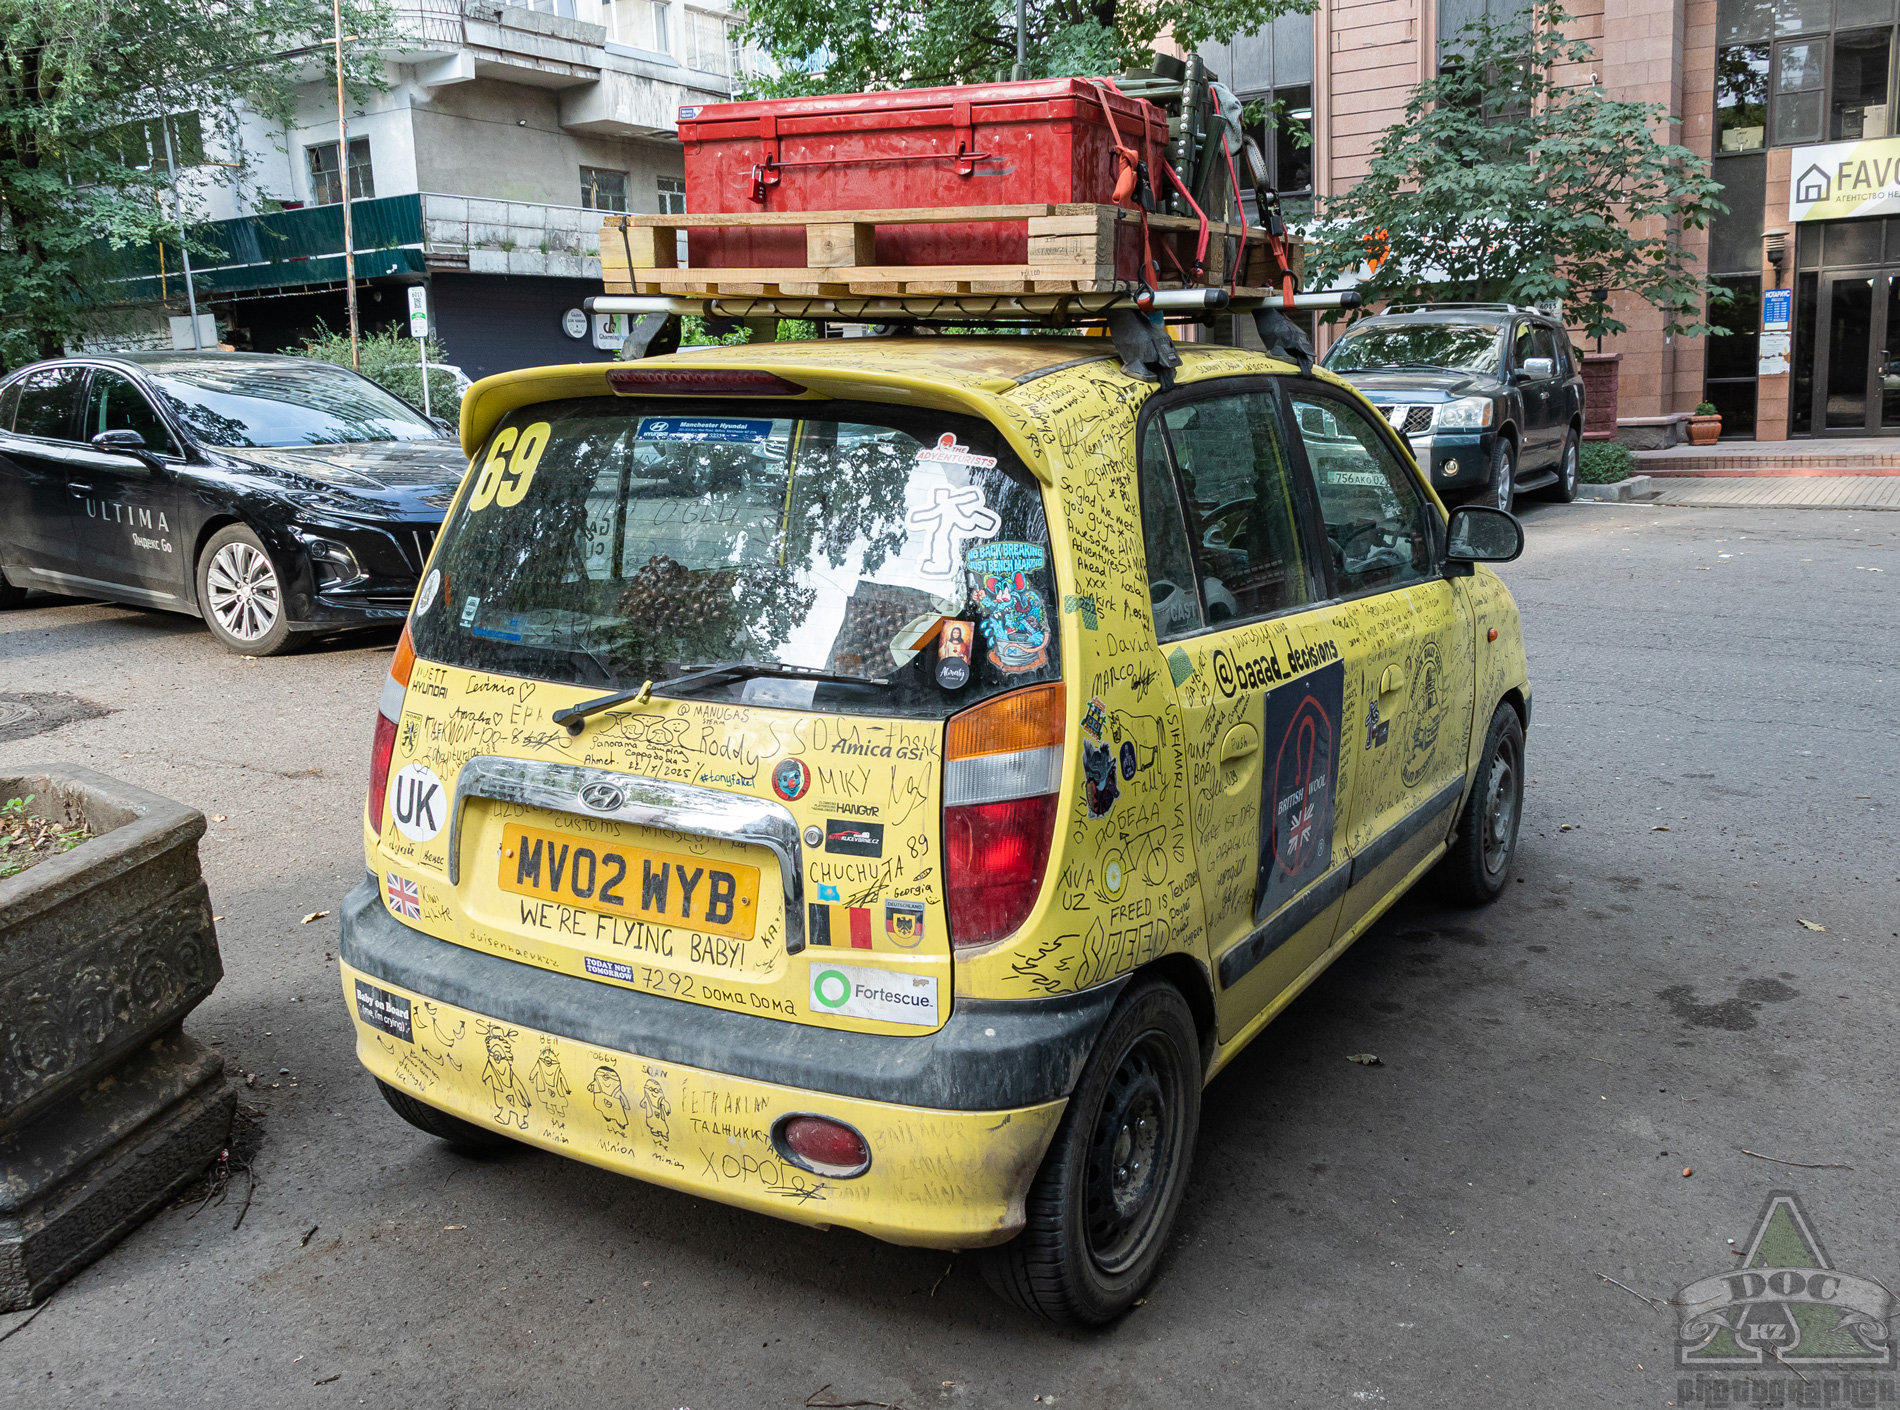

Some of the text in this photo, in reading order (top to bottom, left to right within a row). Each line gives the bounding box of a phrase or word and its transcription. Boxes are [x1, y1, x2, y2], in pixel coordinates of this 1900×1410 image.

[1836, 191, 1885, 203] АГЕНТСТВО
[470, 422, 551, 511] 69
[917, 452, 995, 467] ADVENTURISTS
[1336, 472, 1354, 483] 756
[86, 498, 169, 532] ULTIMA
[132, 533, 172, 553] Яндекс Go
[967, 543, 1043, 560] NO BACK BREAKING
[1106, 631, 1153, 656] David
[1213, 634, 1338, 698] @baaad_decisions
[412, 681, 448, 699] HYUNDAI
[1092, 664, 1134, 699] MARCO
[831, 739, 926, 761] Amica GSi
[1231, 735, 1248, 748] Push
[818, 764, 871, 797] MIKY
[397, 775, 439, 832] UK
[1278, 774, 1325, 815] BRITISH WOOL
[907, 834, 929, 858] 89
[641, 859, 737, 926] WYB
[887, 902, 923, 910] DEUTSCHLAND
[520, 899, 587, 936] WE'RE
[596, 914, 673, 957] FLYING
[690, 932, 746, 972] BABY!
[586, 957, 632, 974] TODAY NOT
[587, 965, 633, 981] TOMORROW
[641, 966, 695, 998] 7292
[356, 989, 409, 1020] Baby on Board
